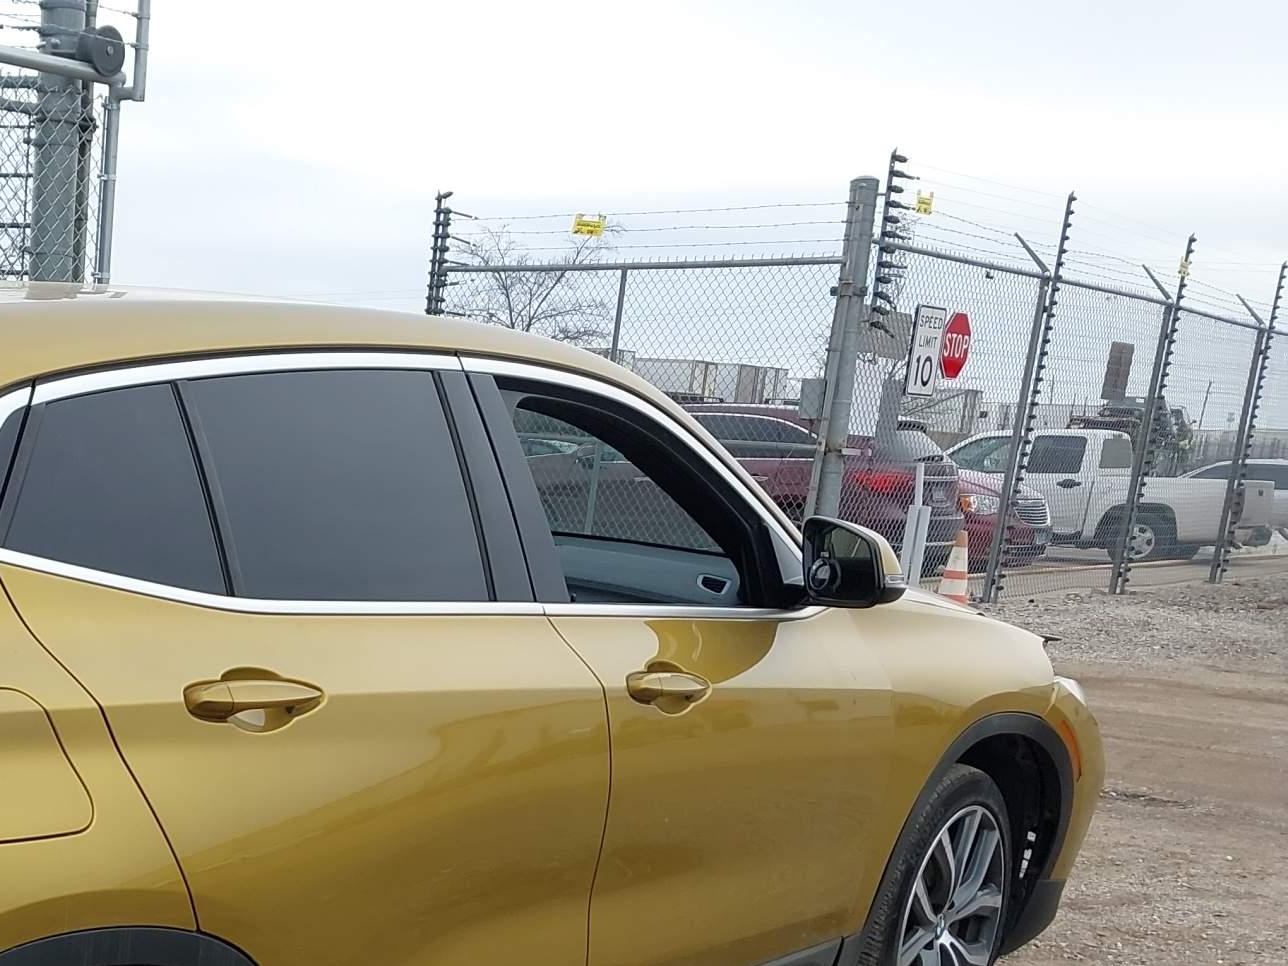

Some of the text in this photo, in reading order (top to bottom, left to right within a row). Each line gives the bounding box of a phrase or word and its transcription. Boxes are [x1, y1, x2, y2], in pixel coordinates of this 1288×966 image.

[919, 315, 943, 330] SPEED
[918, 335, 938, 349] LIMIT
[943, 333, 970, 359] STOP
[914, 355, 933, 387] 10
